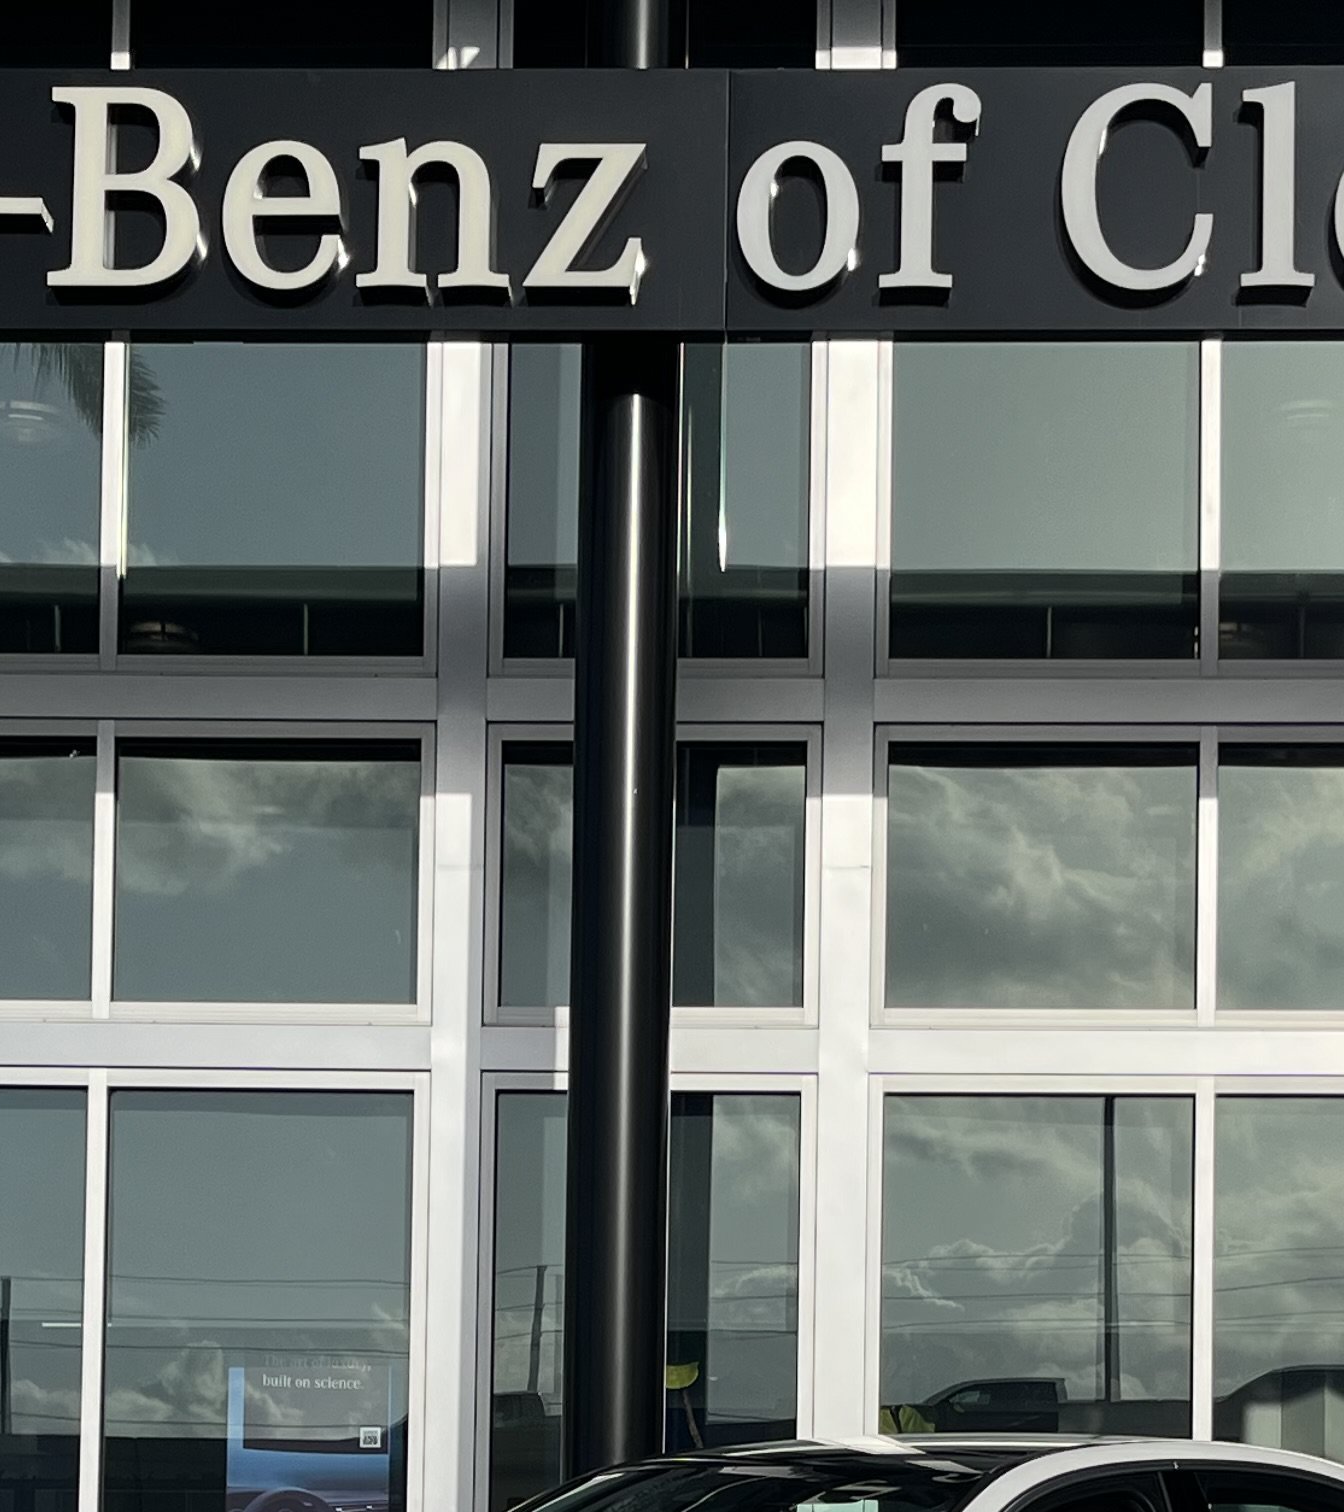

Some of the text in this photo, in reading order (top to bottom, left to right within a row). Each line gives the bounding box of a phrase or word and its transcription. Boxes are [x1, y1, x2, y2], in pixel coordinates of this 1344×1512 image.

[735, 82, 982, 292] of
[262, 1373, 364, 1390] built on science.
